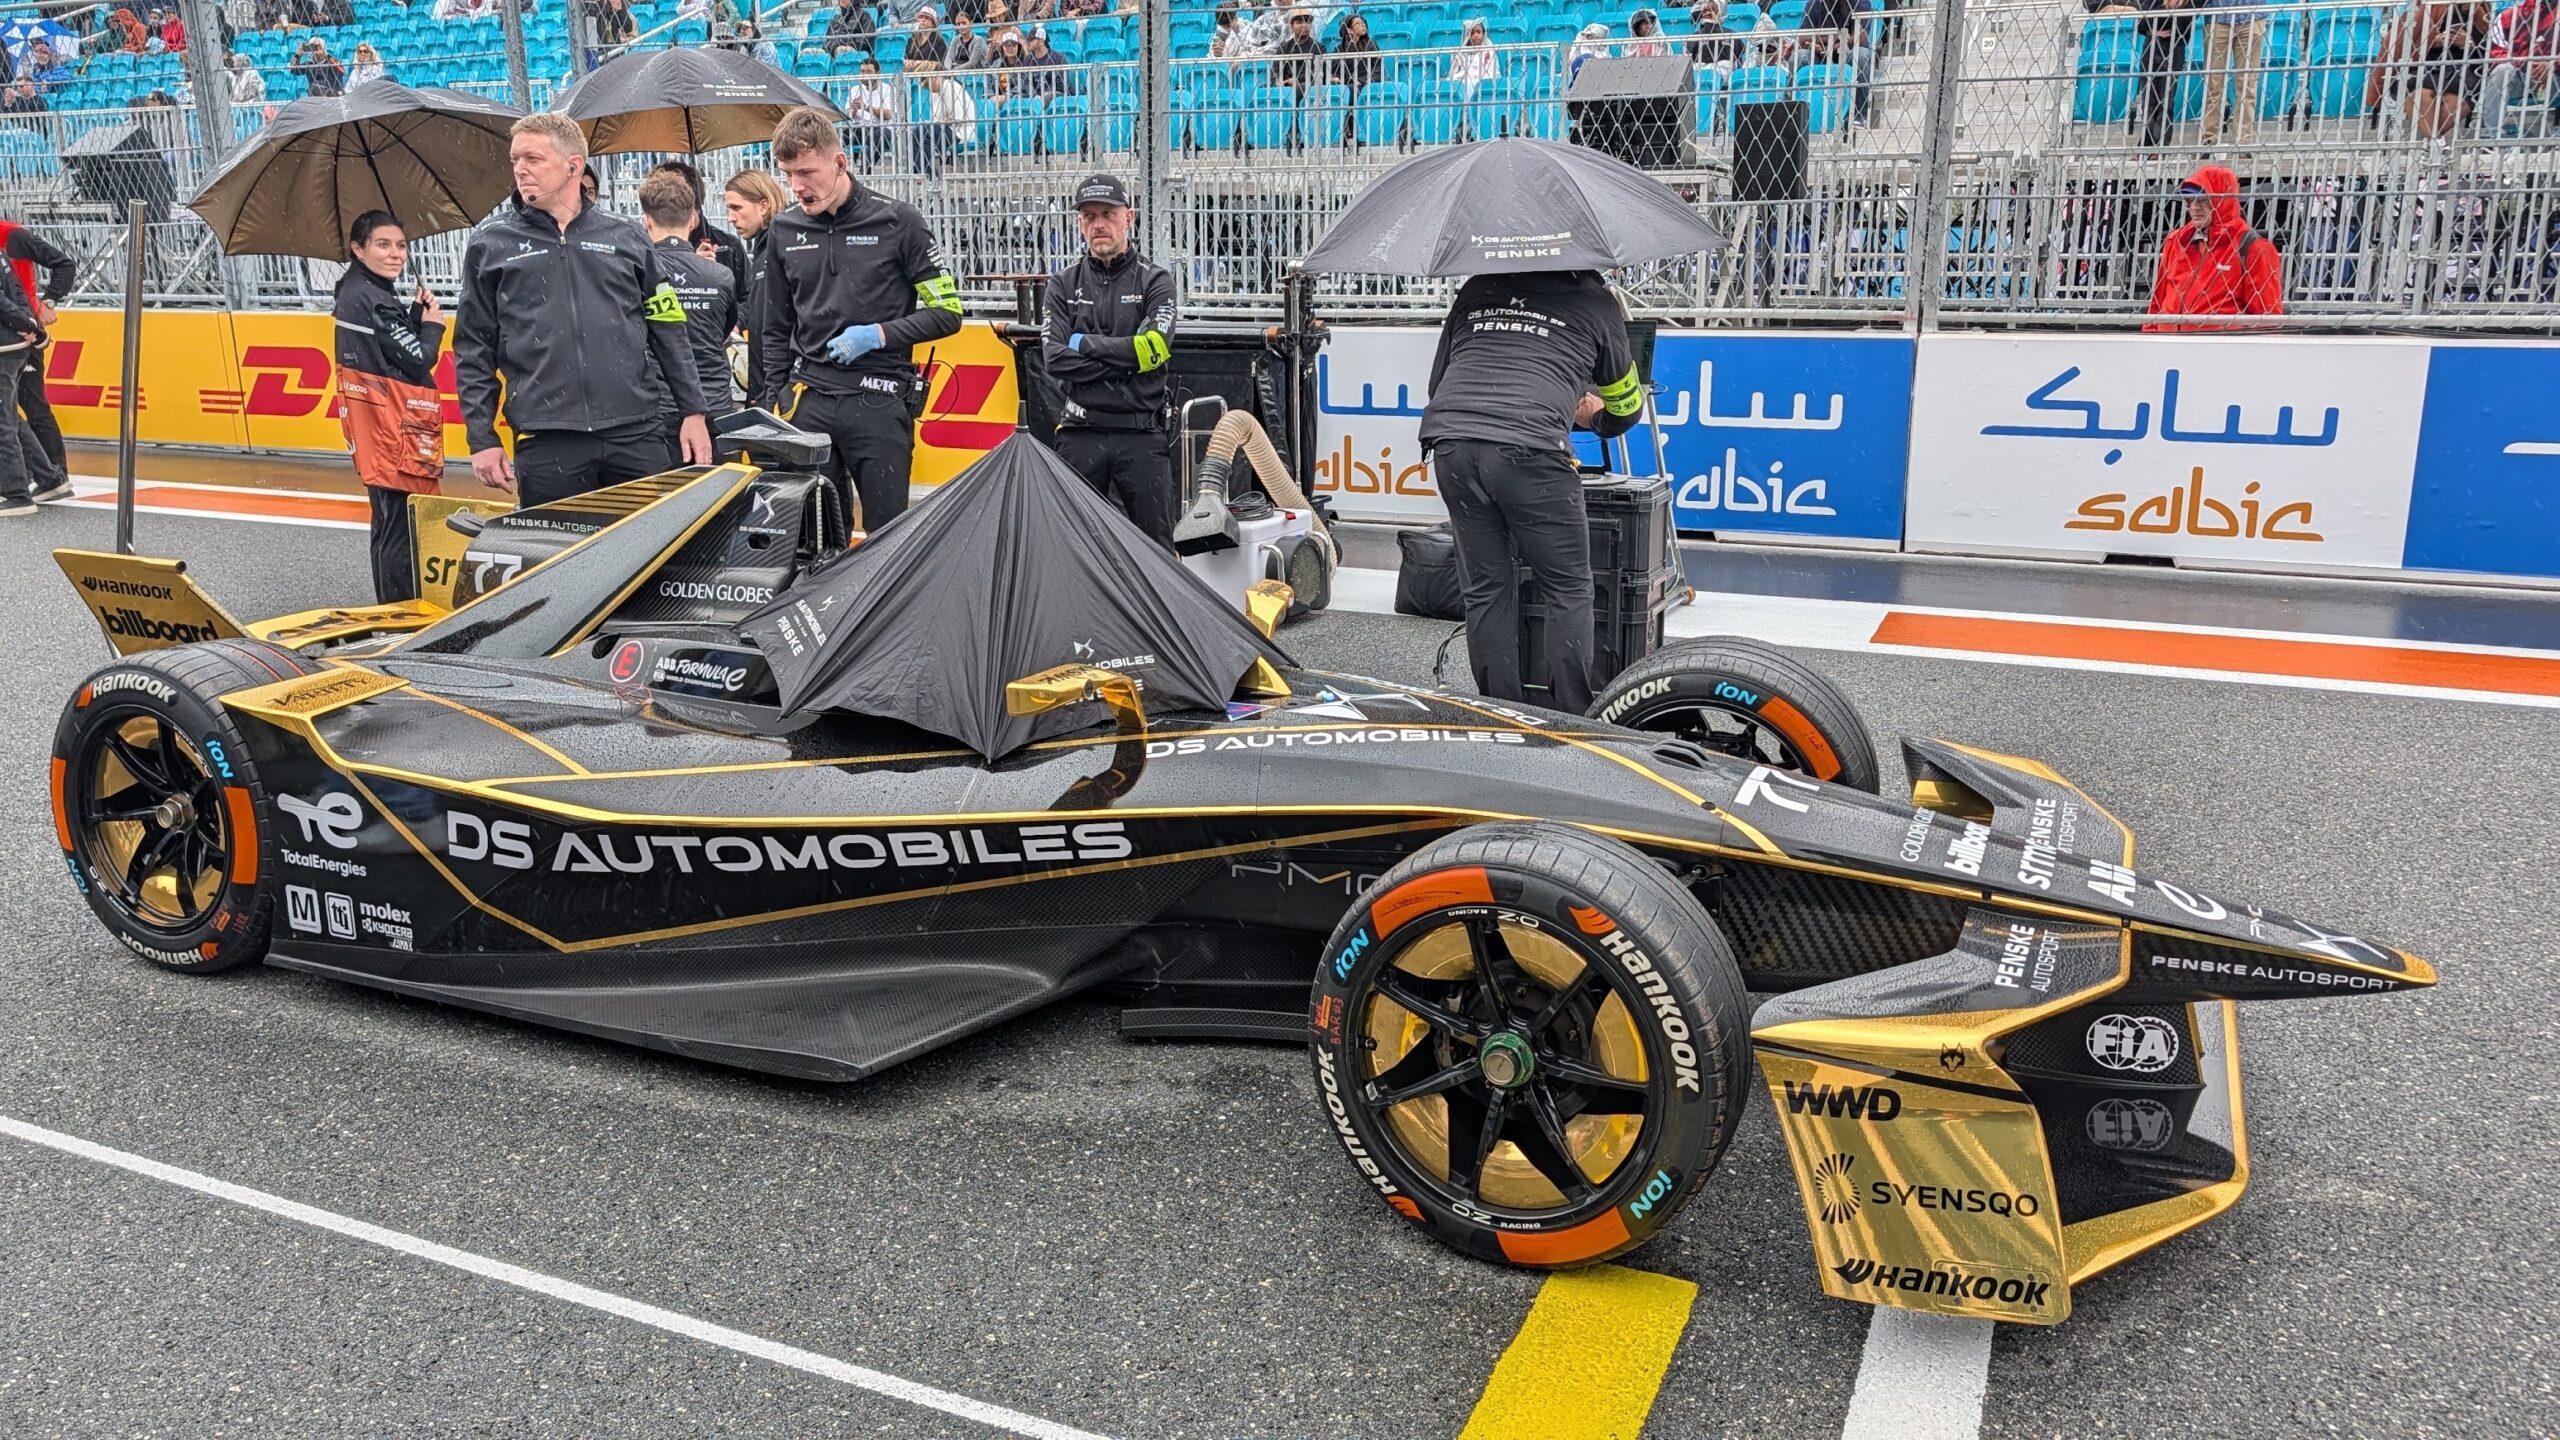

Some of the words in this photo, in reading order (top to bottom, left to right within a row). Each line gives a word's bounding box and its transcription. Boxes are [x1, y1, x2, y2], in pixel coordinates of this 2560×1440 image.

[1500, 232, 1572, 242] AUTOMOBILES
[1484, 248, 1561, 259] PENSKE
[1473, 322, 1550, 337] PENSKE
[1980, 366, 2340, 465] سابك
[2064, 466, 2324, 542] sabic
[503, 518, 549, 528] PENSKE
[466, 550, 522, 594] 77
[660, 580, 714, 600] GOLDEN
[717, 584, 774, 604] GLOBES
[98, 606, 220, 643] billboard
[656, 657, 676, 672] ABB
[675, 659, 729, 682] FORMULA
[684, 678, 724, 690] CHAMPIONSHIP
[1146, 740, 1206, 759] DS
[1215, 729, 1527, 751] AUTOMOBILES
[446, 812, 534, 870] DS
[552, 822, 1133, 874] AUTOMOBILES
[280, 848, 368, 878] TotalEnergies
[290, 890, 316, 922] M
[360, 902, 412, 924] molex
[372, 921, 414, 940] KYOCERA
[1994, 924, 2036, 988] PENSKE
[2030, 929, 2063, 992] AUTOSPORT
[2152, 954, 2248, 976] PENSKE
[2252, 966, 2399, 991] AUTOSPORT
[1782, 1080, 1902, 1121] WWD
[1871, 1182, 2039, 1218] SYENSQO
[1500, 1222, 1540, 1230] RACING
